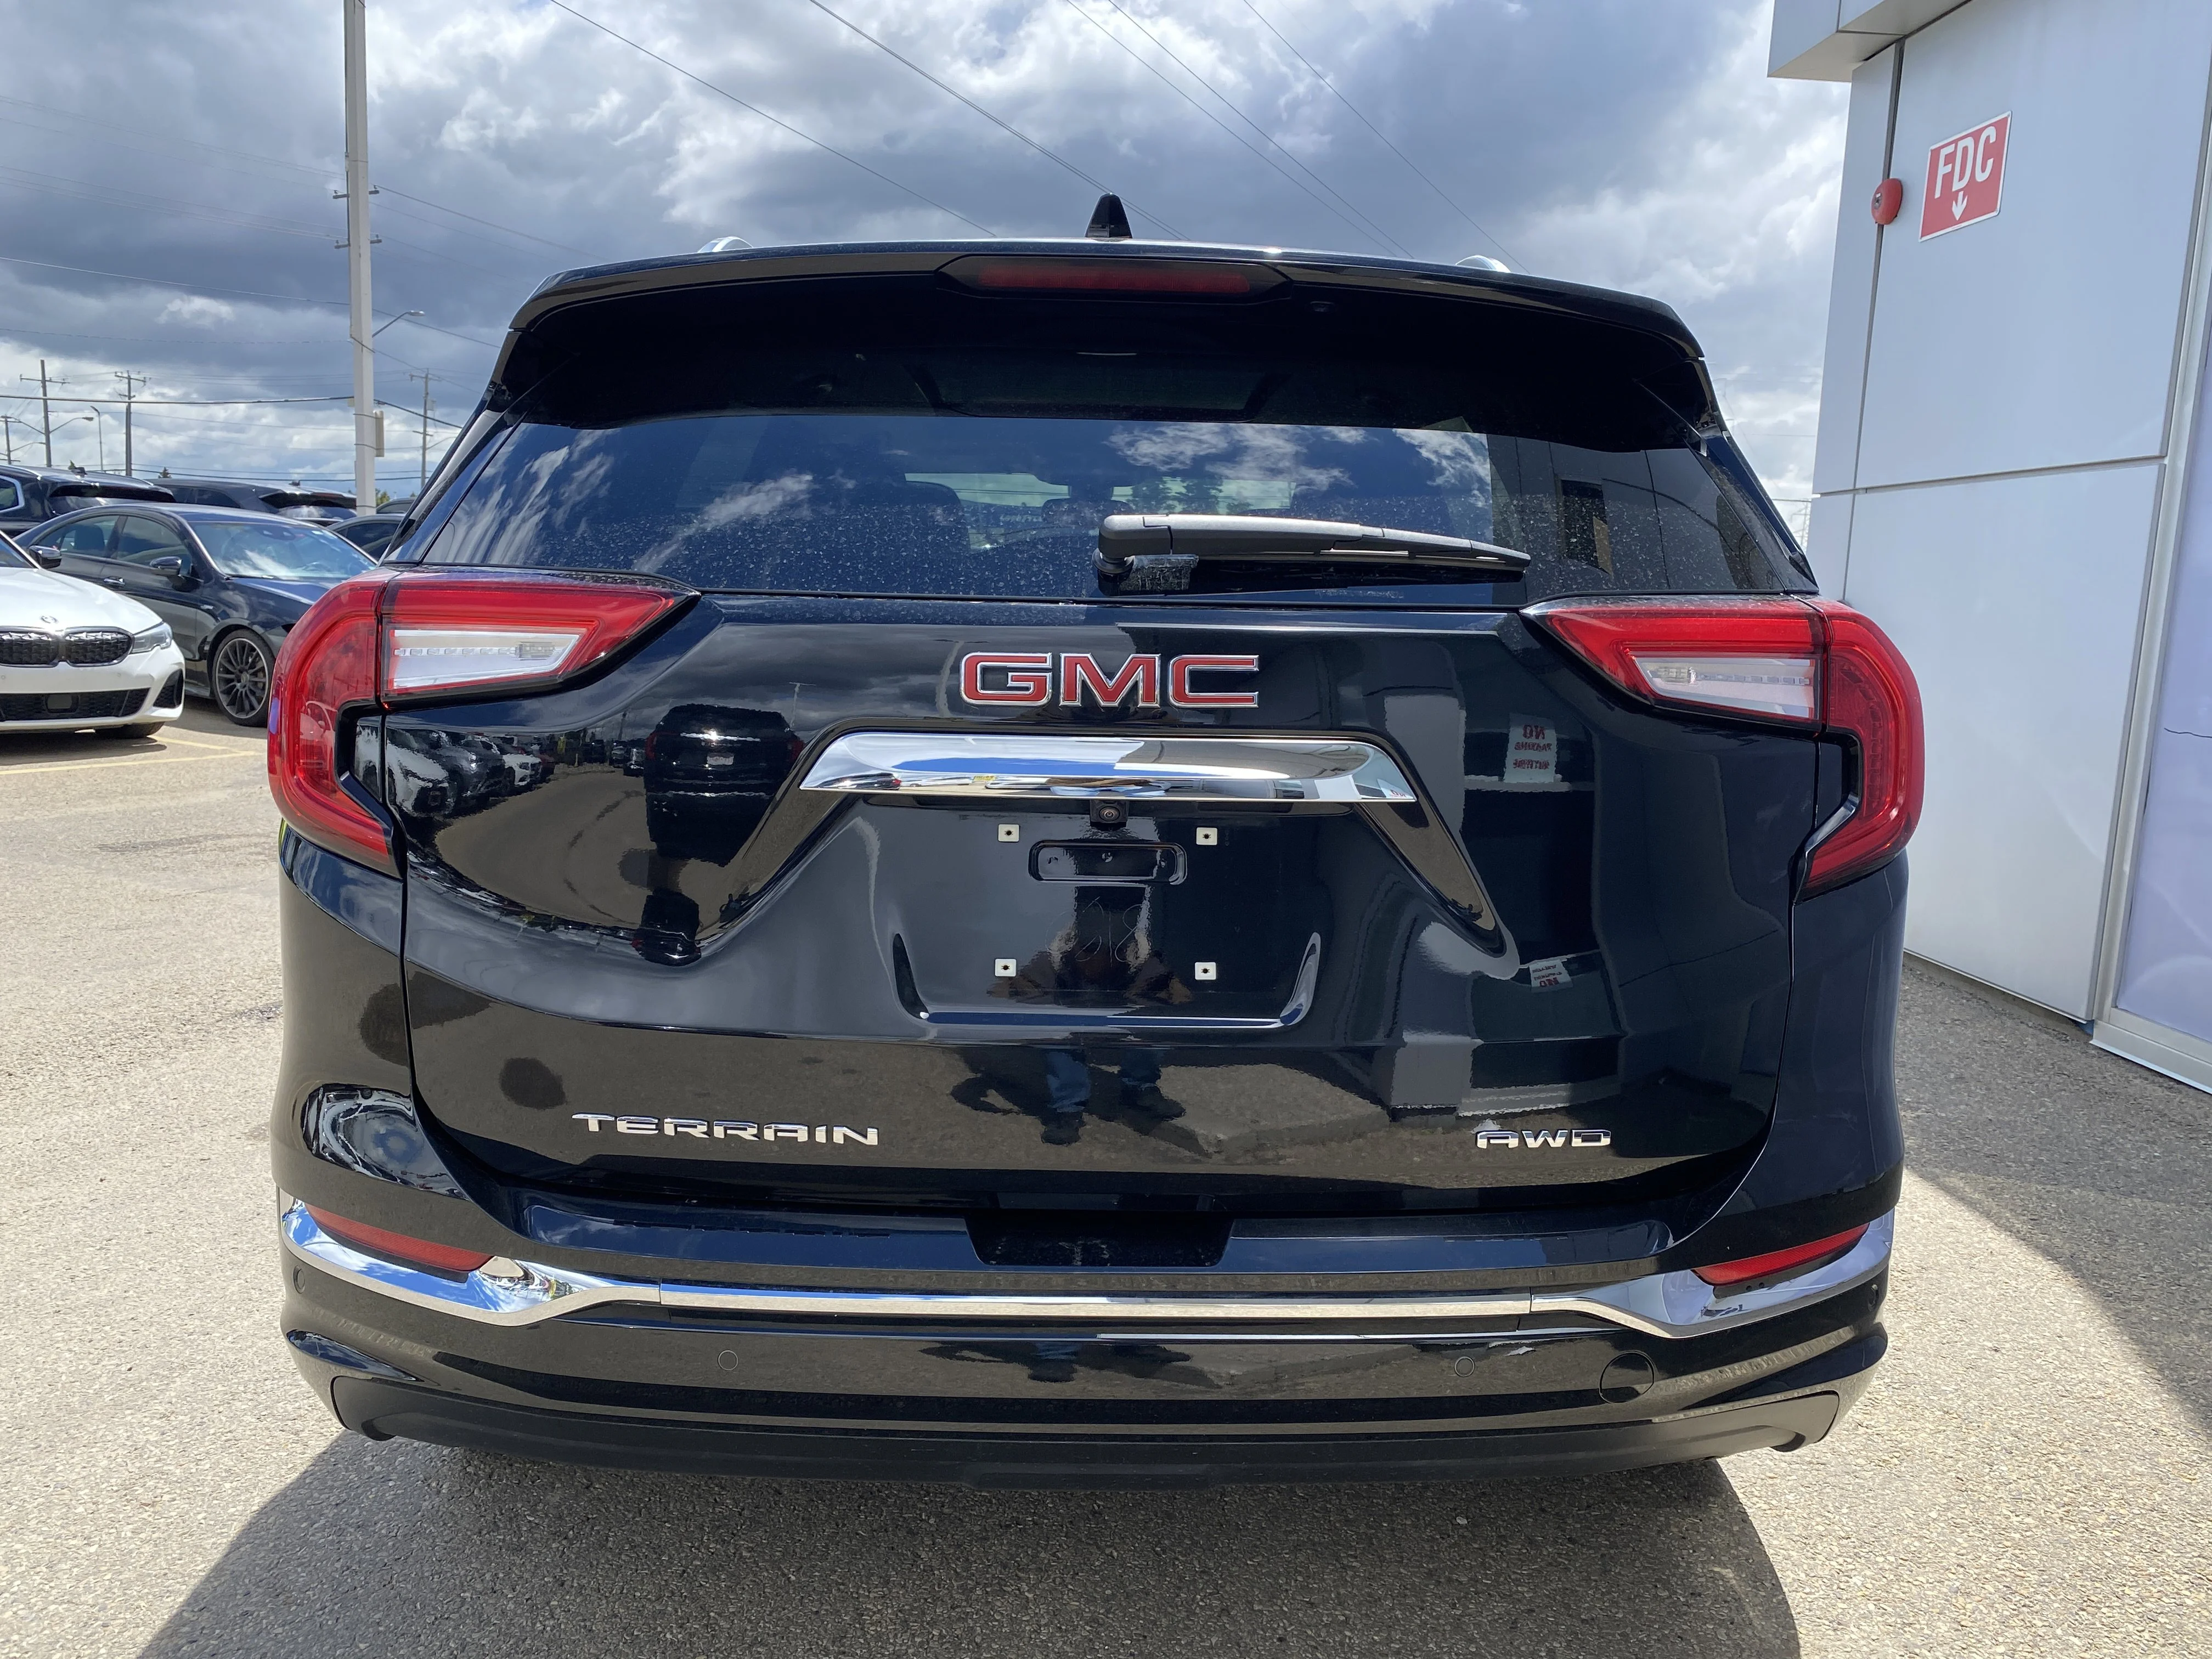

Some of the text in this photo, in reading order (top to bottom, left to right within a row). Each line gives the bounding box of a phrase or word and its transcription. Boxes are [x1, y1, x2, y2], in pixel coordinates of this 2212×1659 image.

[1934, 126, 1996, 199] FDC
[960, 652, 1259, 708] GMC
[572, 1112, 878, 1146] TERRAIN
[1476, 1128, 1611, 1149] AWD
